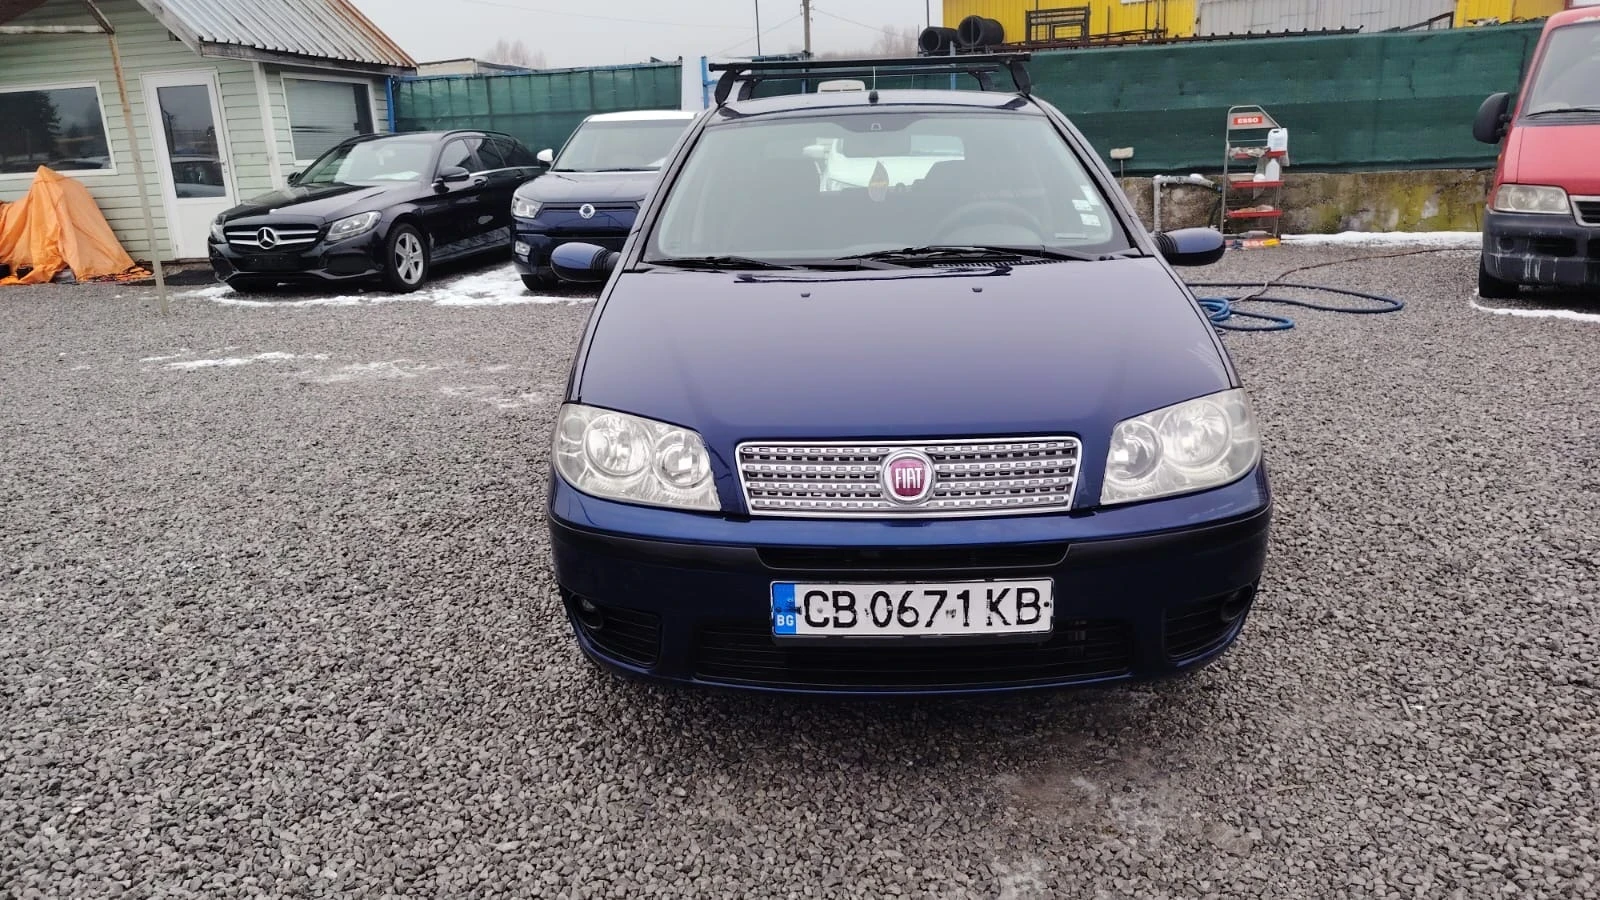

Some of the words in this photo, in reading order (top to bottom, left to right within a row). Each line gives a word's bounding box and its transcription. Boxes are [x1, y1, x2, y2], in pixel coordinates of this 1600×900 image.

[895, 467, 923, 489] FIAT
[804, 590, 858, 628] CB
[870, 589, 970, 628] 0671
[986, 587, 1041, 626] KB
[776, 614, 795, 626] BG
